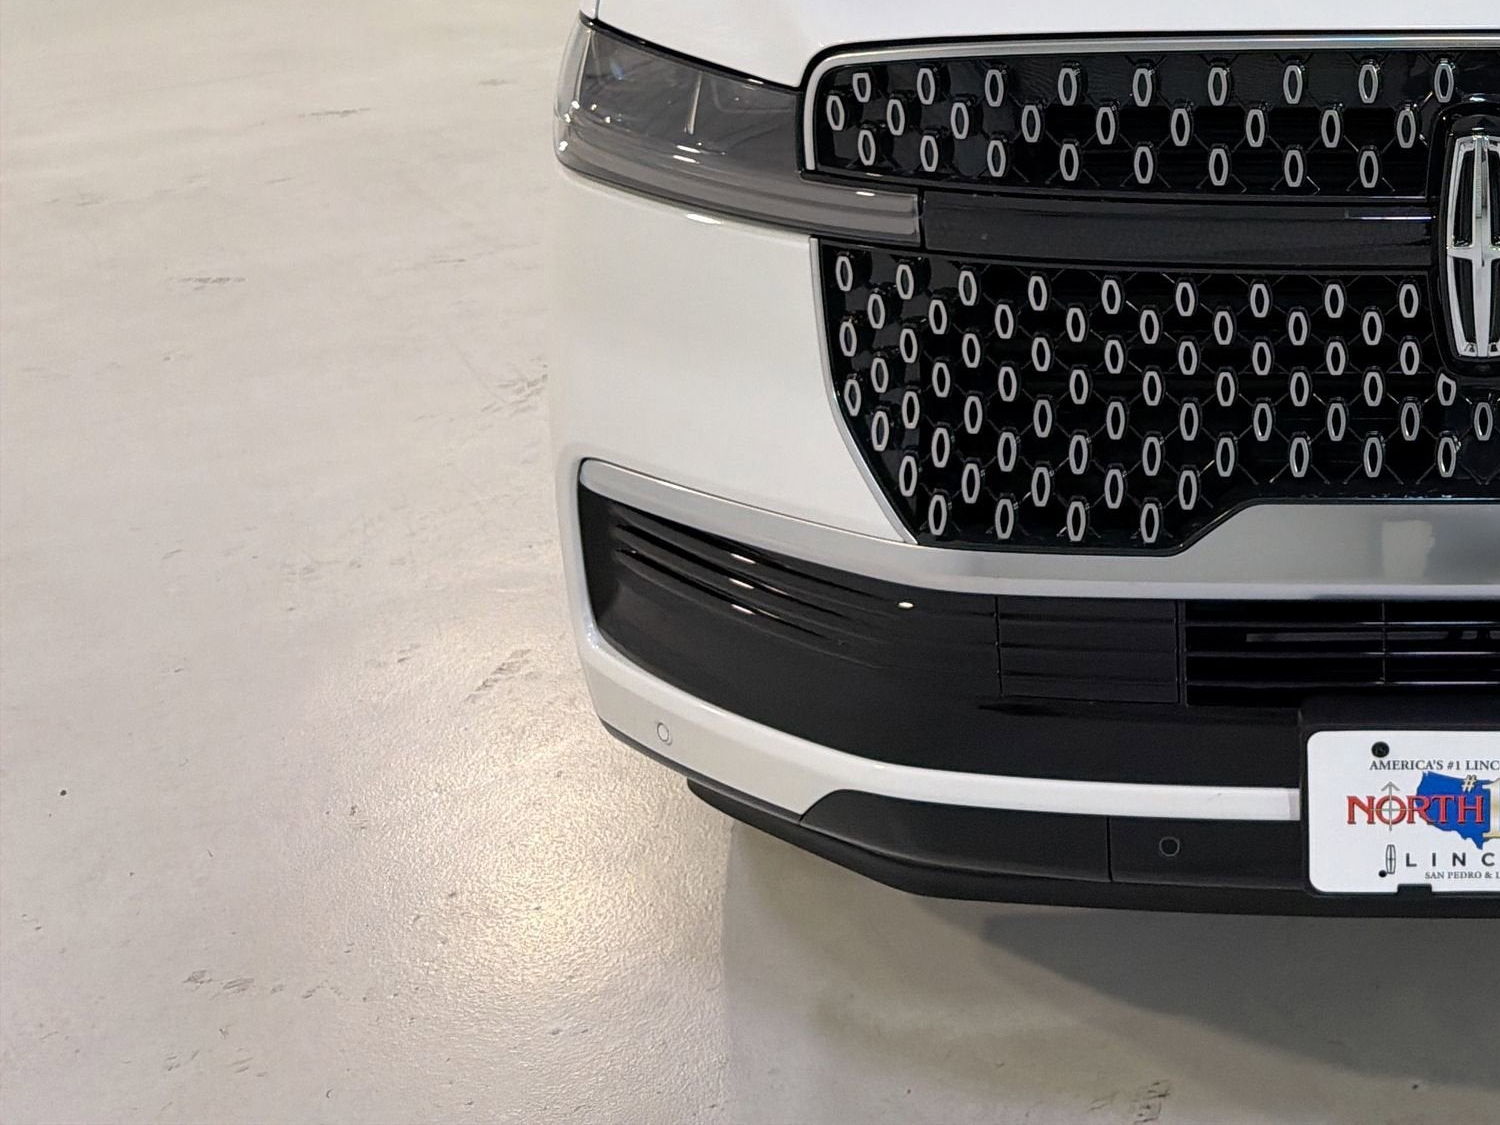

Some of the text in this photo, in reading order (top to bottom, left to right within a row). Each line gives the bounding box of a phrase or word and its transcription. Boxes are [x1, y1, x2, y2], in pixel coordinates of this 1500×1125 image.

[1369, 760, 1444, 772] AMERICA'S
[1447, 760, 1461, 771] #1
[1346, 794, 1484, 825] NORTH
[1425, 871, 1445, 880] SAN
[1447, 871, 1483, 880] PEDRO
[1484, 871, 1493, 880] &
